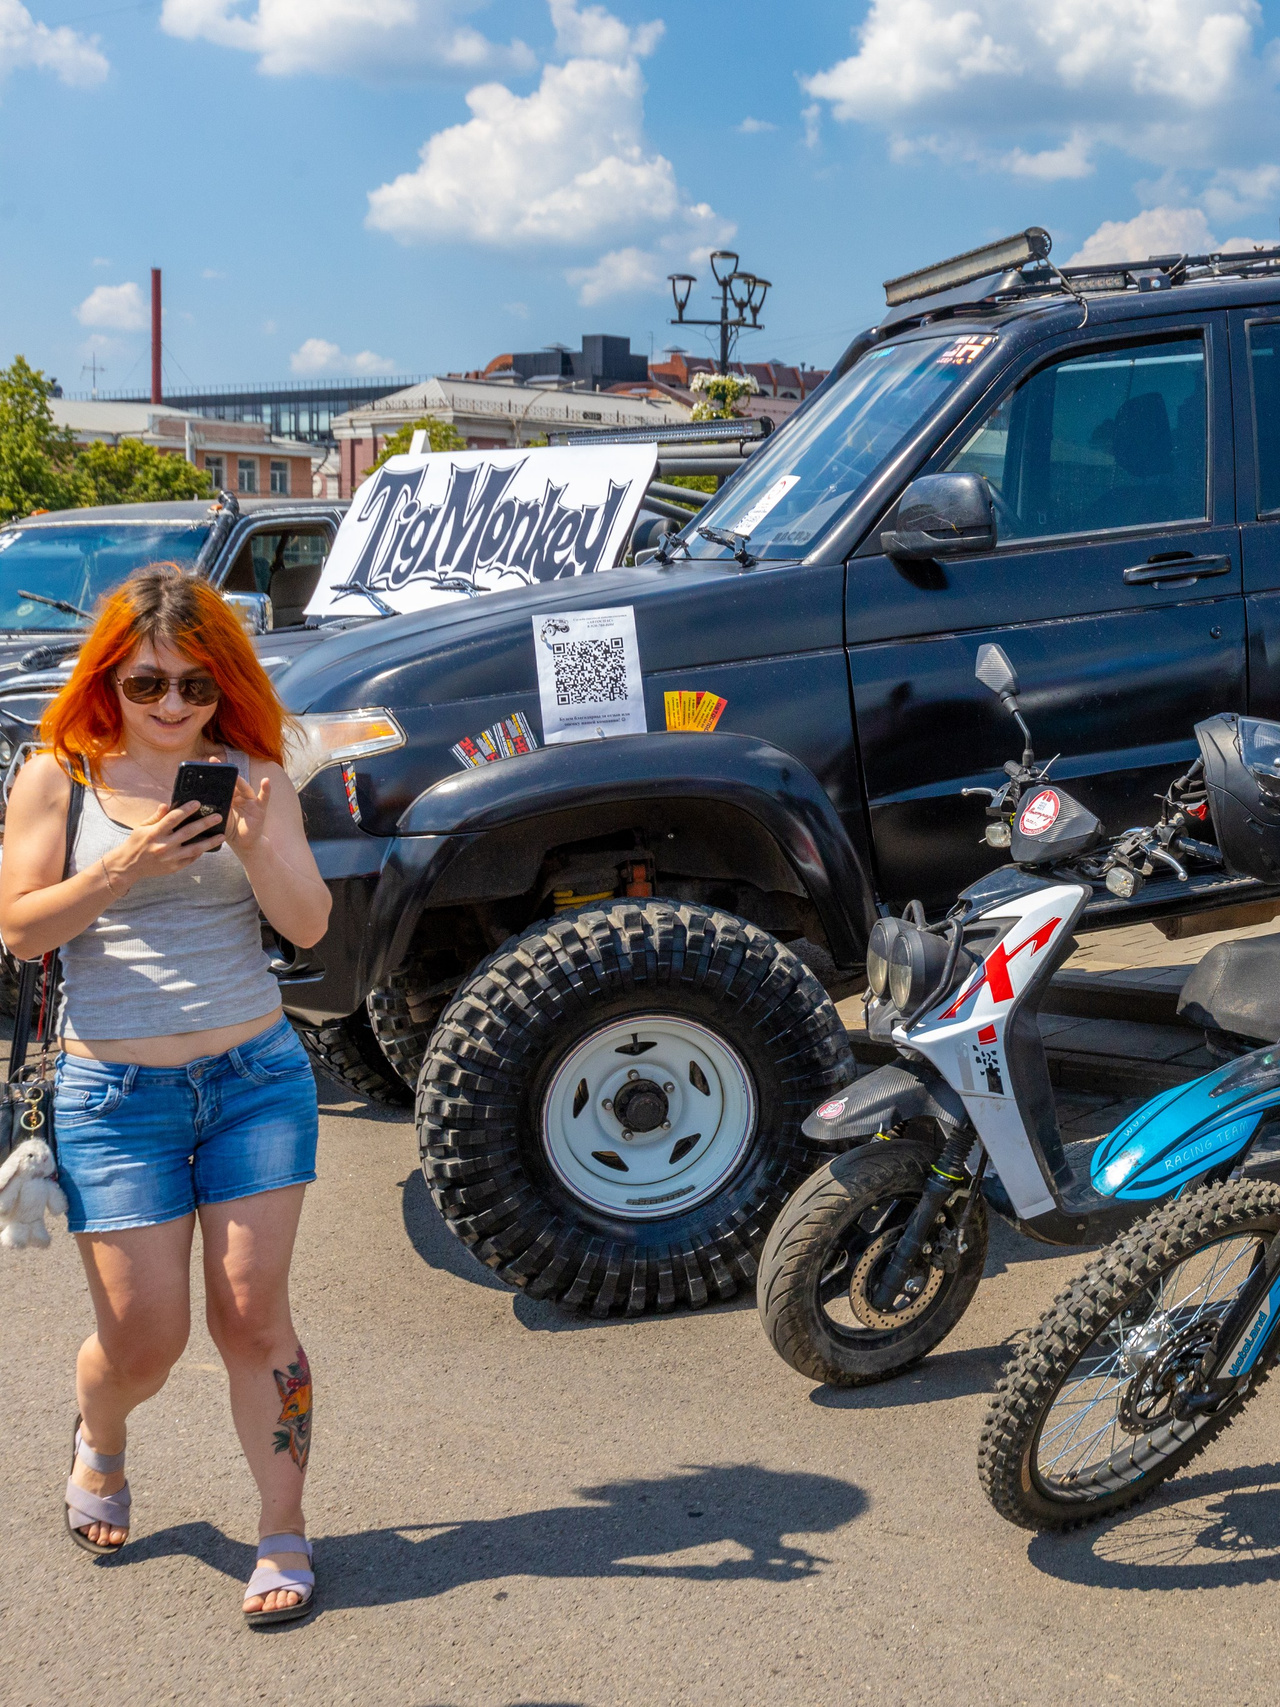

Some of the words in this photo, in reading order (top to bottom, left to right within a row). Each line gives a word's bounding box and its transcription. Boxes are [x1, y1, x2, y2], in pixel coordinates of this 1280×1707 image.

[332, 455, 633, 602] TigMonkey
[1164, 1139, 1213, 1171] RACING
[1217, 1120, 1249, 1143] TEAM
[1228, 1311, 1267, 1377] MotoLand
